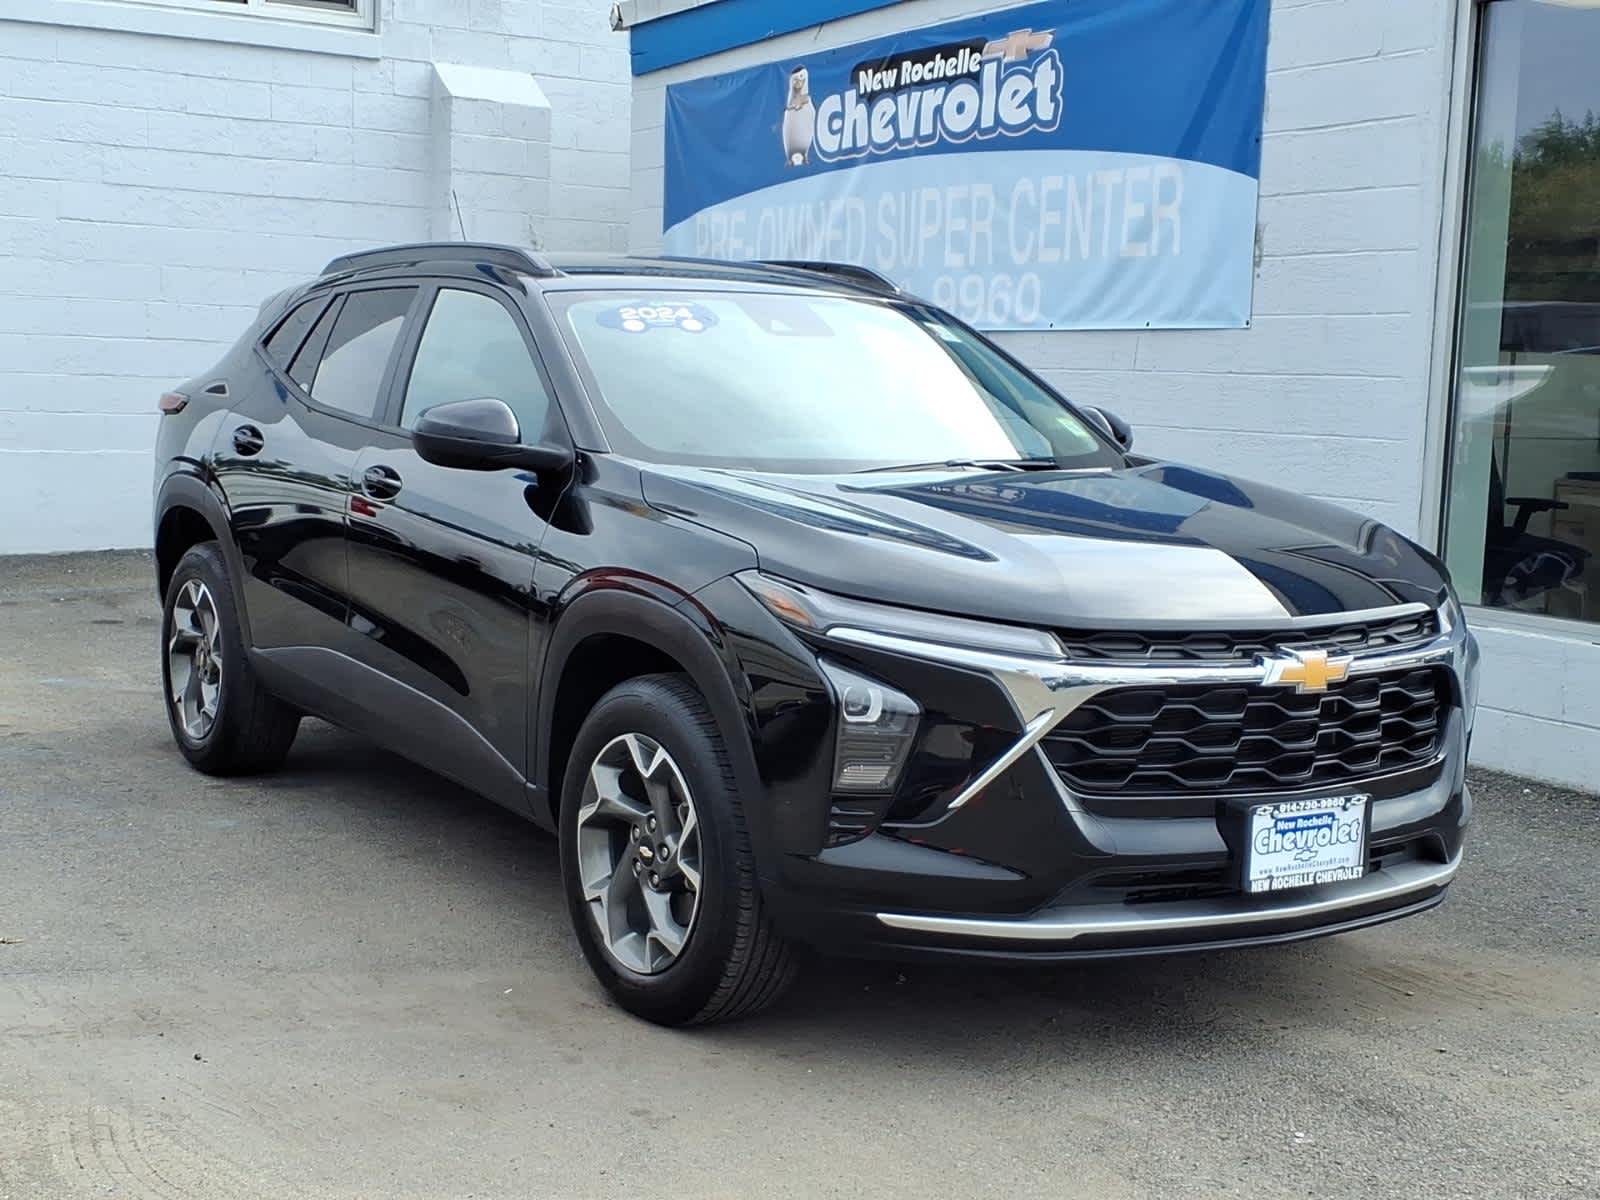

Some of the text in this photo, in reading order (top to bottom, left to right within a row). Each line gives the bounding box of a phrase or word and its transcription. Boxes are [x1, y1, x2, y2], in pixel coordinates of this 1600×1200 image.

[859, 47, 982, 95] New Rochelle
[815, 57, 1059, 155] Chevrolet
[696, 162, 1185, 270] PRE-OWNED SUPER CENTER
[618, 306, 693, 321] 2024
[1254, 817, 1361, 855] Chevrolet
[1276, 815, 1334, 831] New Rochelle
[1251, 866, 1364, 893] NEW ROCHELLE CHEVROLET
